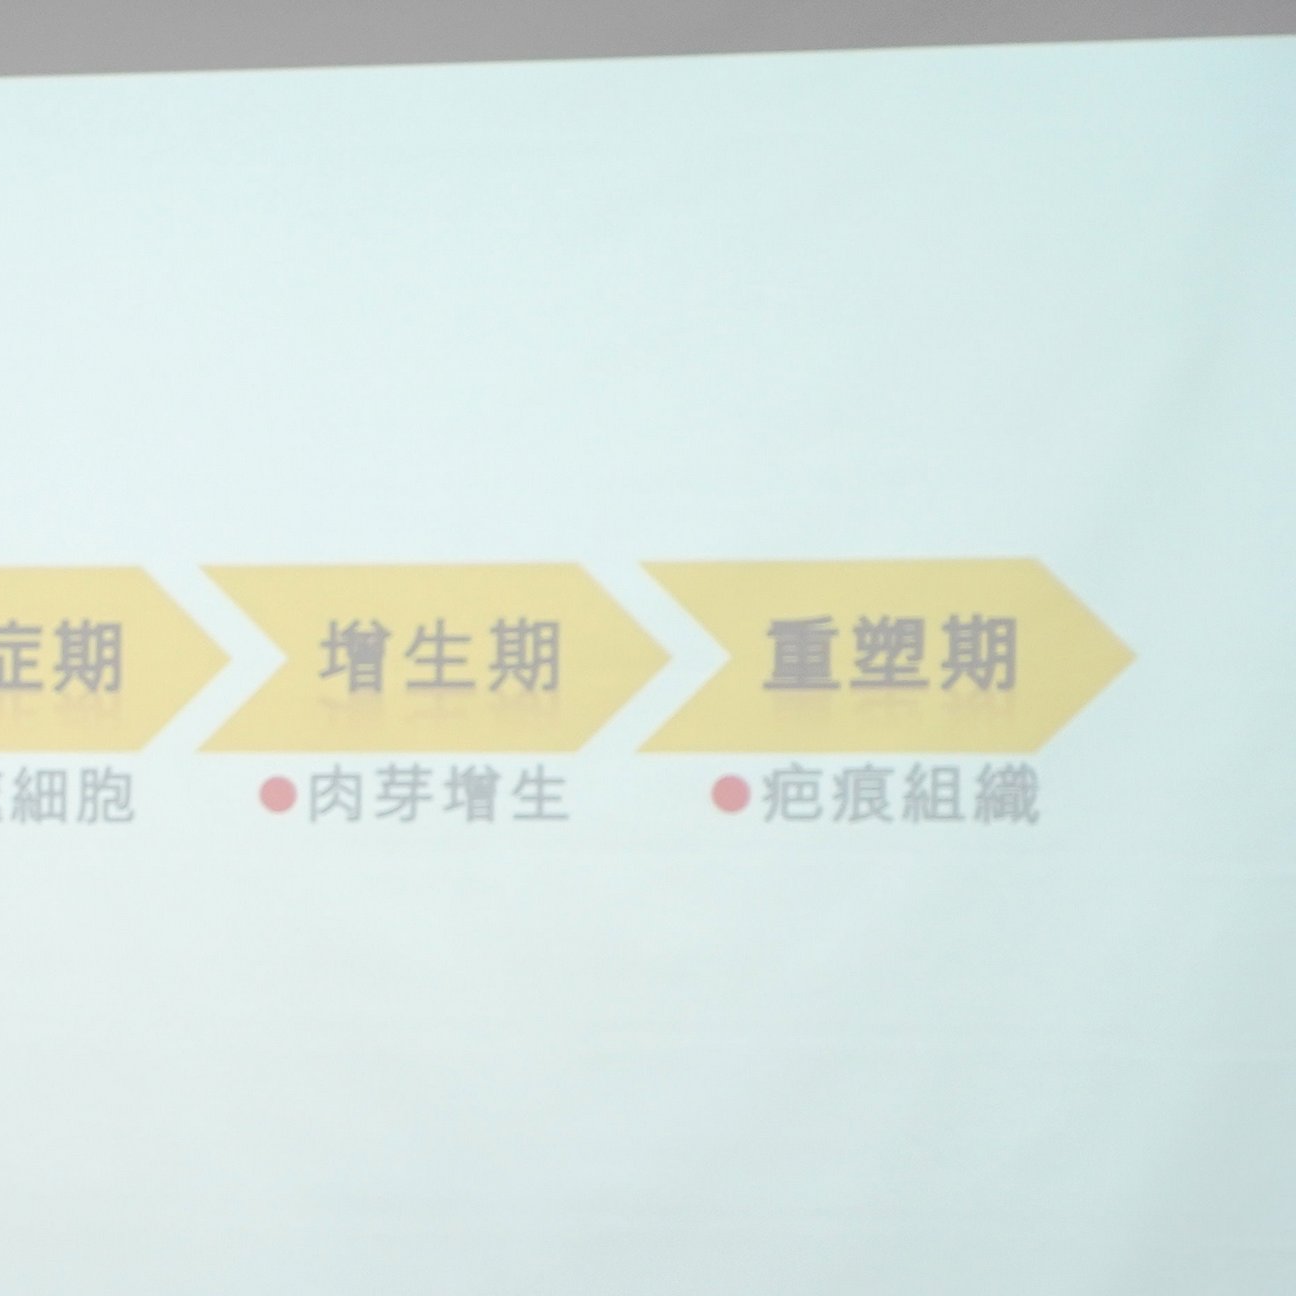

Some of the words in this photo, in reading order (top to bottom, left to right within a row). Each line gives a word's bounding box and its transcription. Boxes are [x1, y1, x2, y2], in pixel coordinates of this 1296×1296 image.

[319, 617, 561, 694] 增生期
[762, 614, 1017, 692] 重塑期
[309, 763, 570, 823] 肉芽增生
[762, 762, 1040, 824] 疤痕組織
